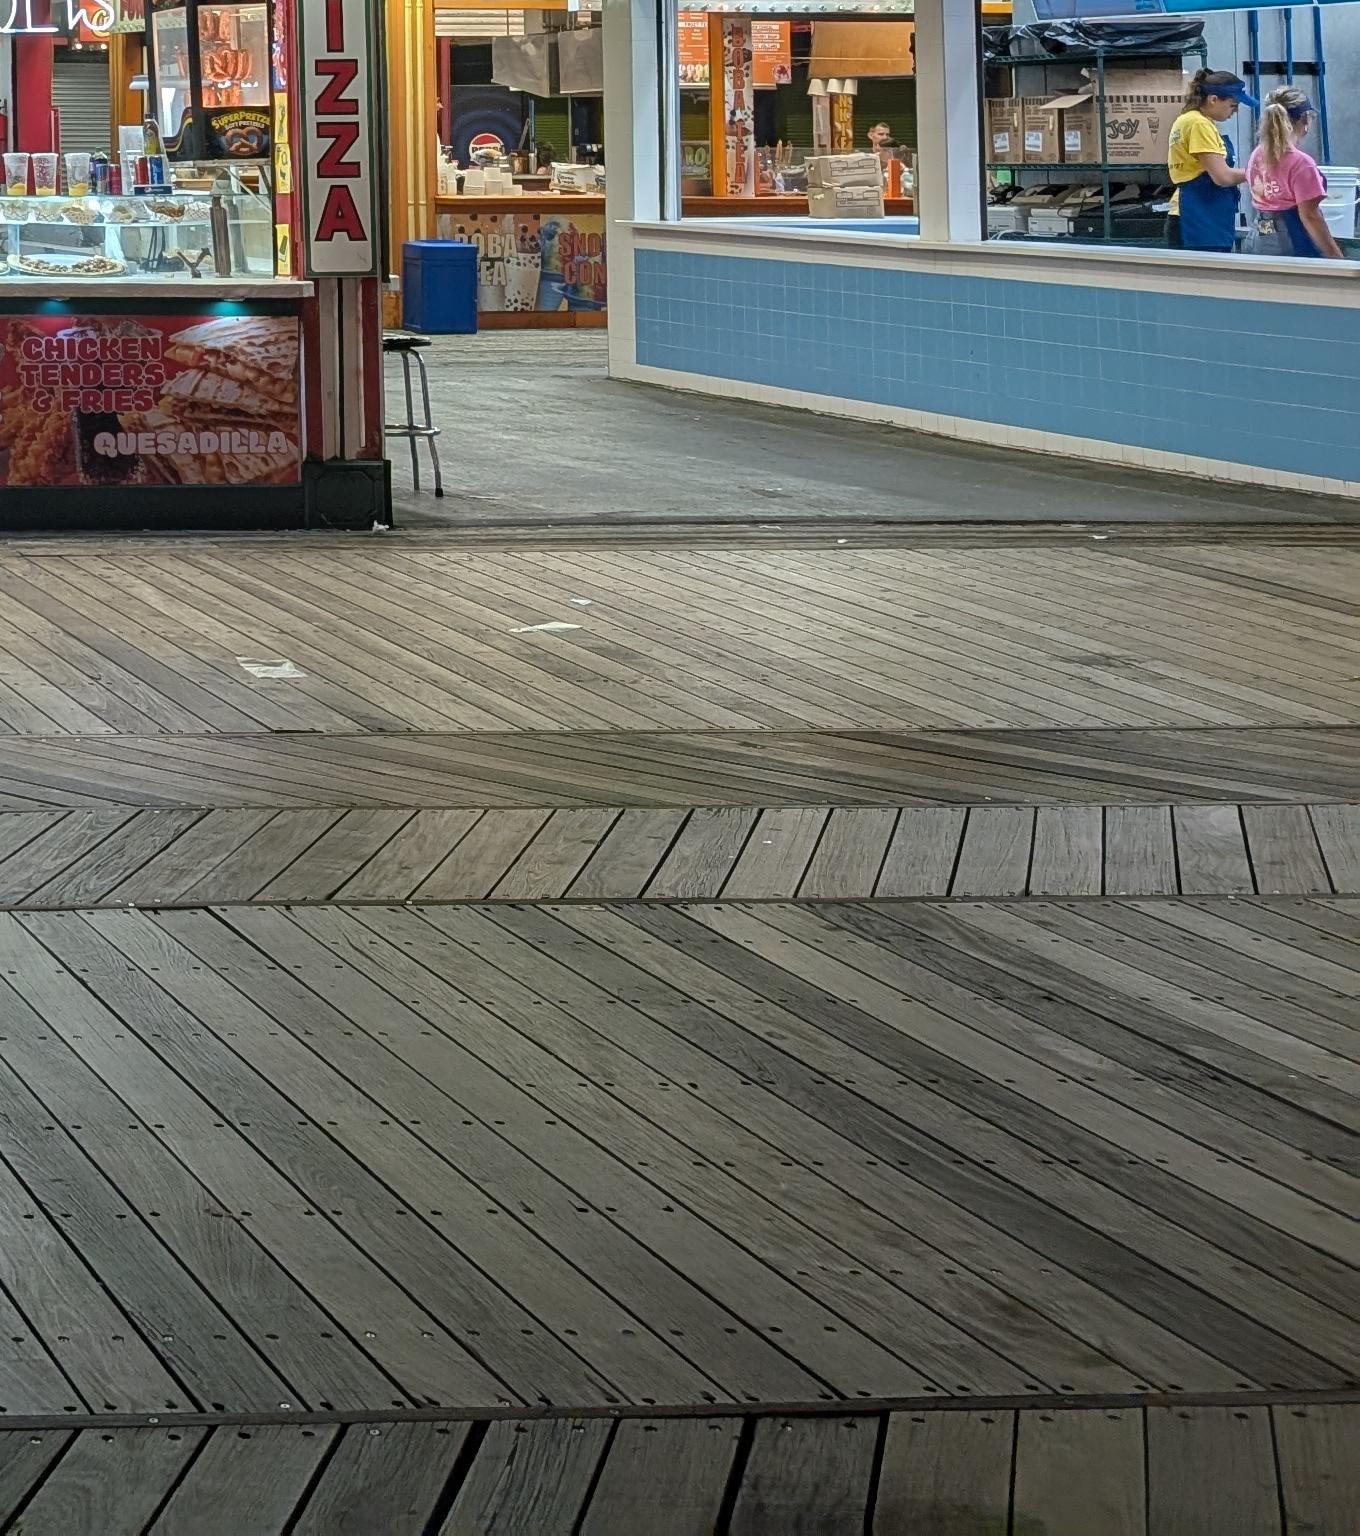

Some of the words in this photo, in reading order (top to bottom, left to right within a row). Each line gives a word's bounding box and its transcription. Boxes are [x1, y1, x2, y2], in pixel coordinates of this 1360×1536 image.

[558, 231, 606, 257] SNO
[480, 260, 508, 286] EA
[563, 261, 607, 285] CON
[21, 336, 164, 363] CHICKEN
[21, 363, 168, 389] TENDERS
[31, 389, 55, 413] &
[61, 389, 155, 413] FRIES
[93, 430, 291, 458] QUESADILLA
